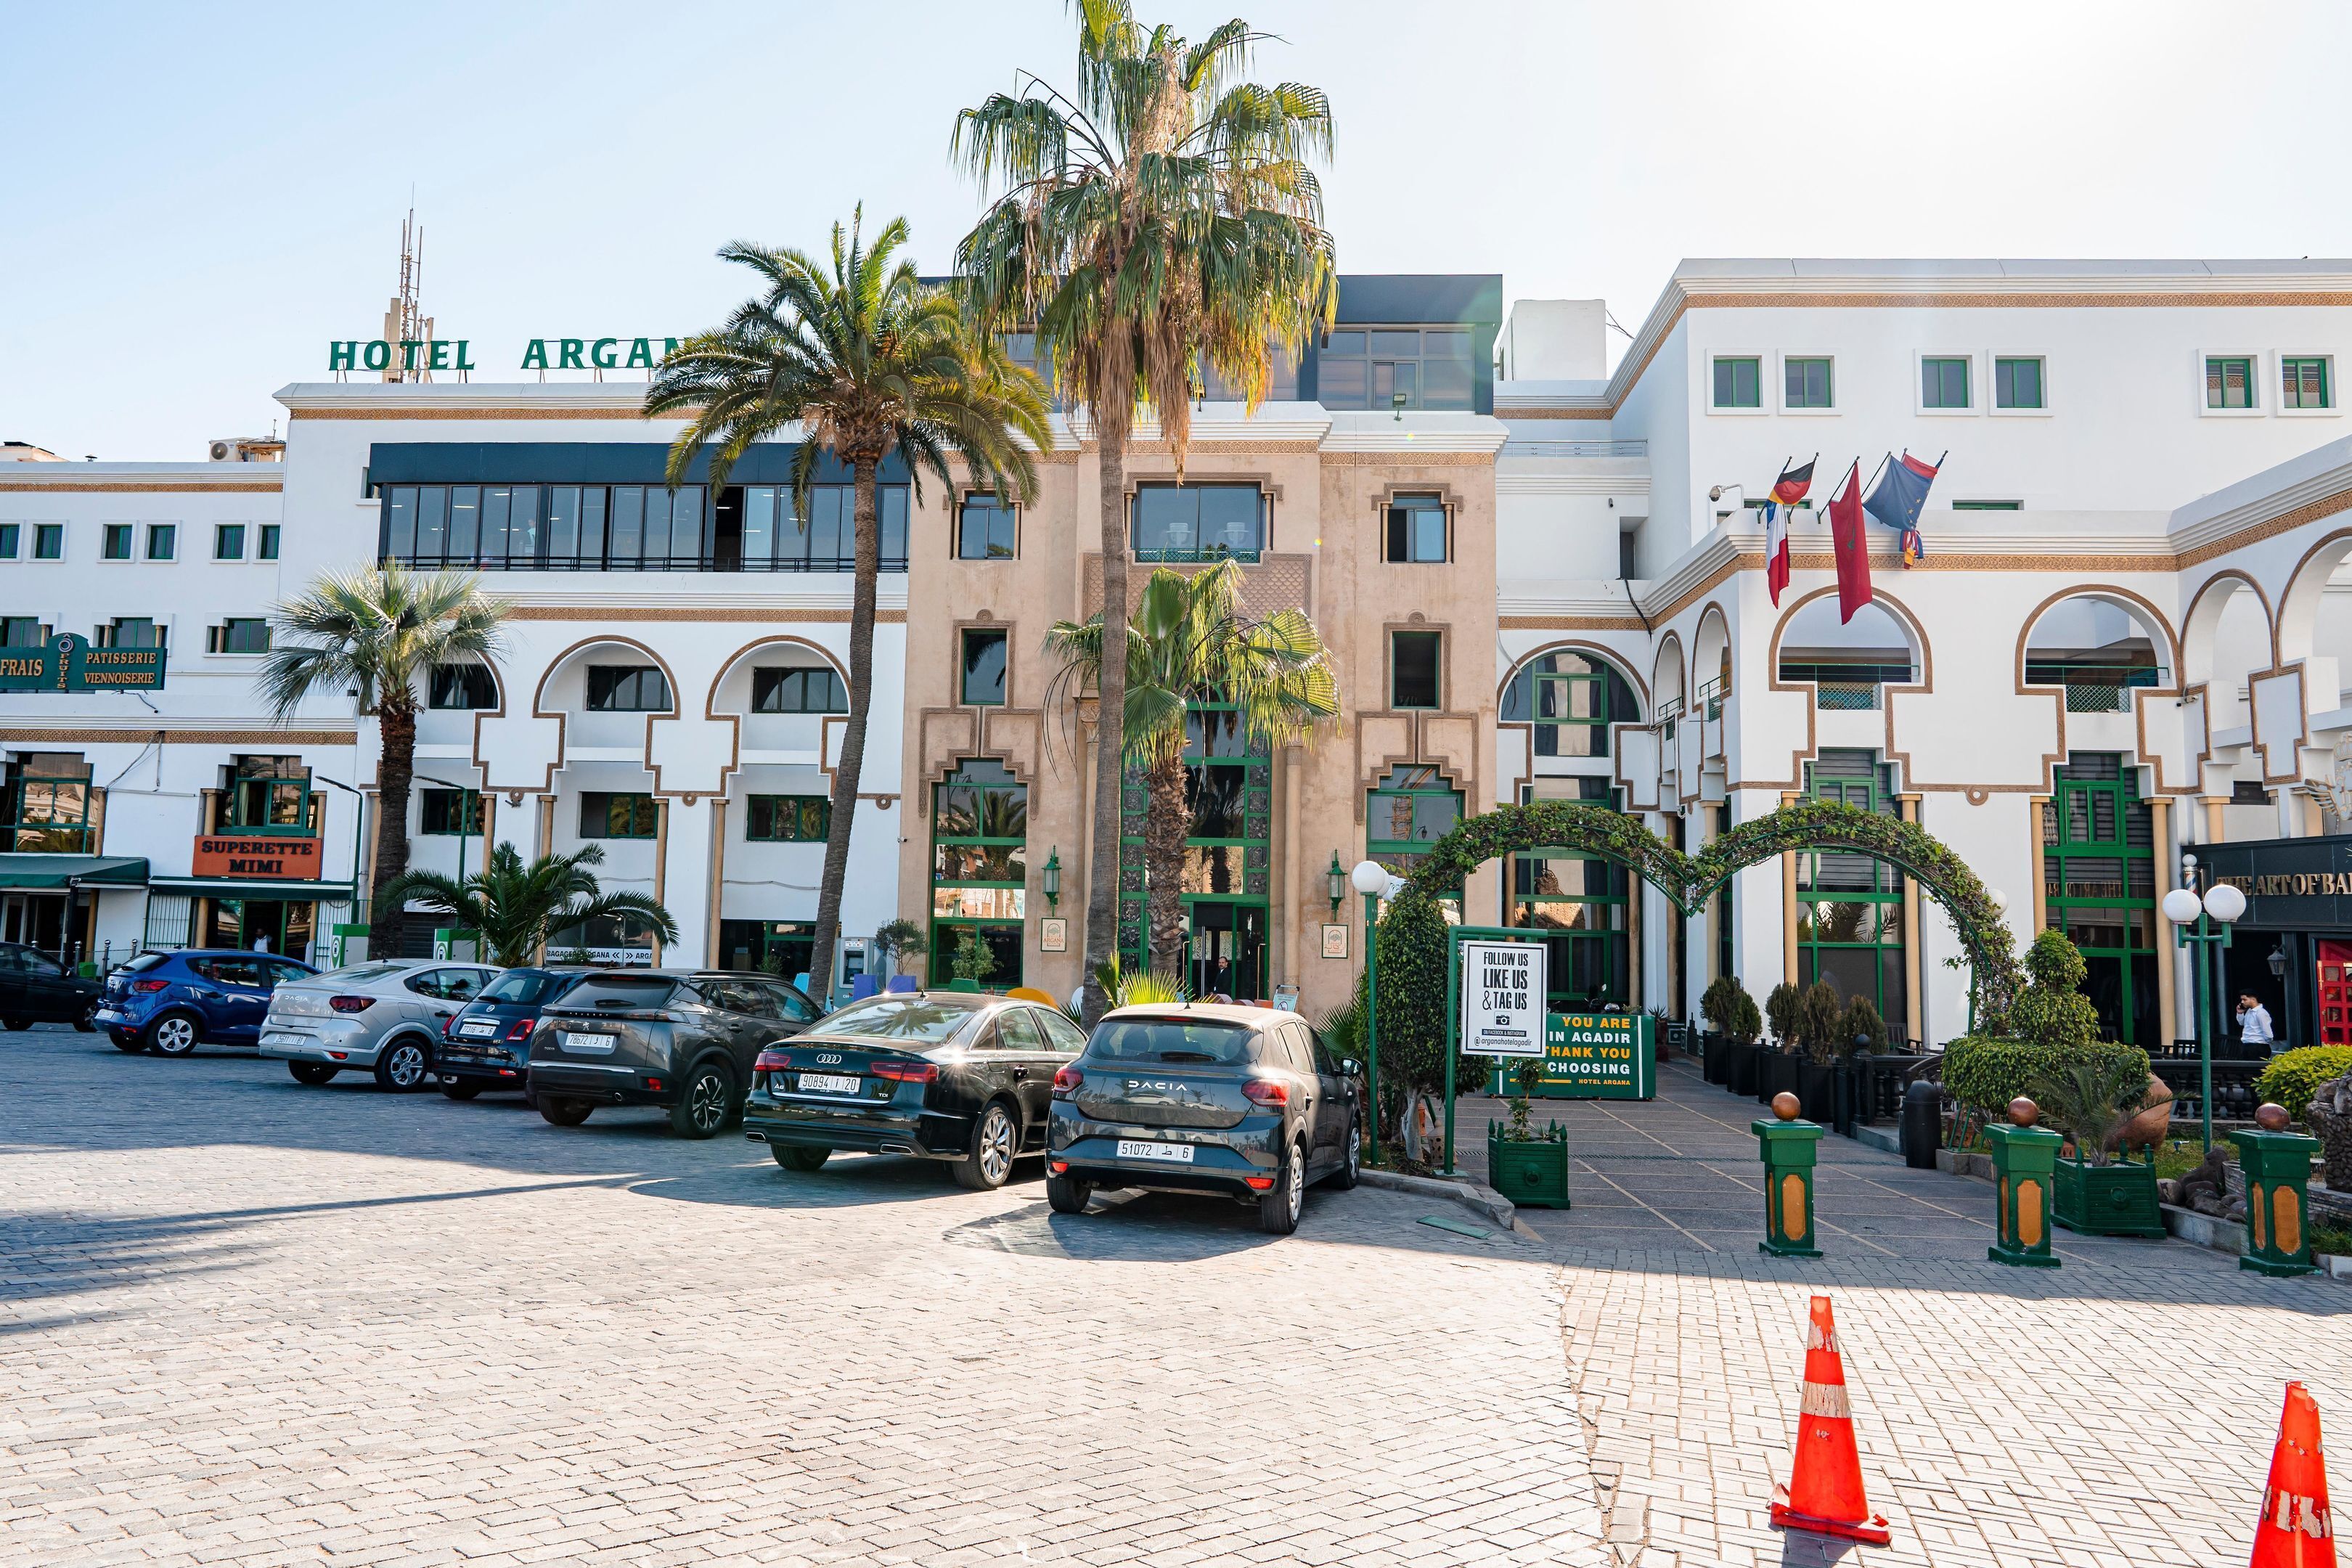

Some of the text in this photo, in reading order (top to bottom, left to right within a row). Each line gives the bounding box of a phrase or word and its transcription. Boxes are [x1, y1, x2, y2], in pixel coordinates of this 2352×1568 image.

[329, 340, 475, 370] HOTEL
[86, 653, 156, 663] PATISSERIE
[0, 659, 43, 676] FRAIS
[57, 653, 70, 688] FRUITS
[84, 672, 155, 684] VIENNOISERIE
[202, 841, 312, 855] SUPERETTE
[229, 859, 283, 873] MIMI
[2253, 875, 2292, 895] ART
[2292, 873, 2319, 895] OF
[1484, 952, 1528, 966] FOLLOW US
[1483, 968, 1527, 989] LIKE US
[1482, 990, 1527, 1010] & TAG US
[1562, 1017, 1630, 1028] YOU ARE
[570, 1034, 588, 1045] 78672
[605, 1037, 611, 1046] 6
[1549, 1031, 1630, 1044] IN AGADIR
[1600, 1048, 1630, 1059] YOU
[1548, 1061, 1630, 1074] CHOOSING
[803, 1075, 829, 1088] 90894
[845, 1078, 856, 1090] 20
[1128, 1080, 1188, 1091] DACIA
[1122, 1143, 1188, 1159] 51072 ط 6
